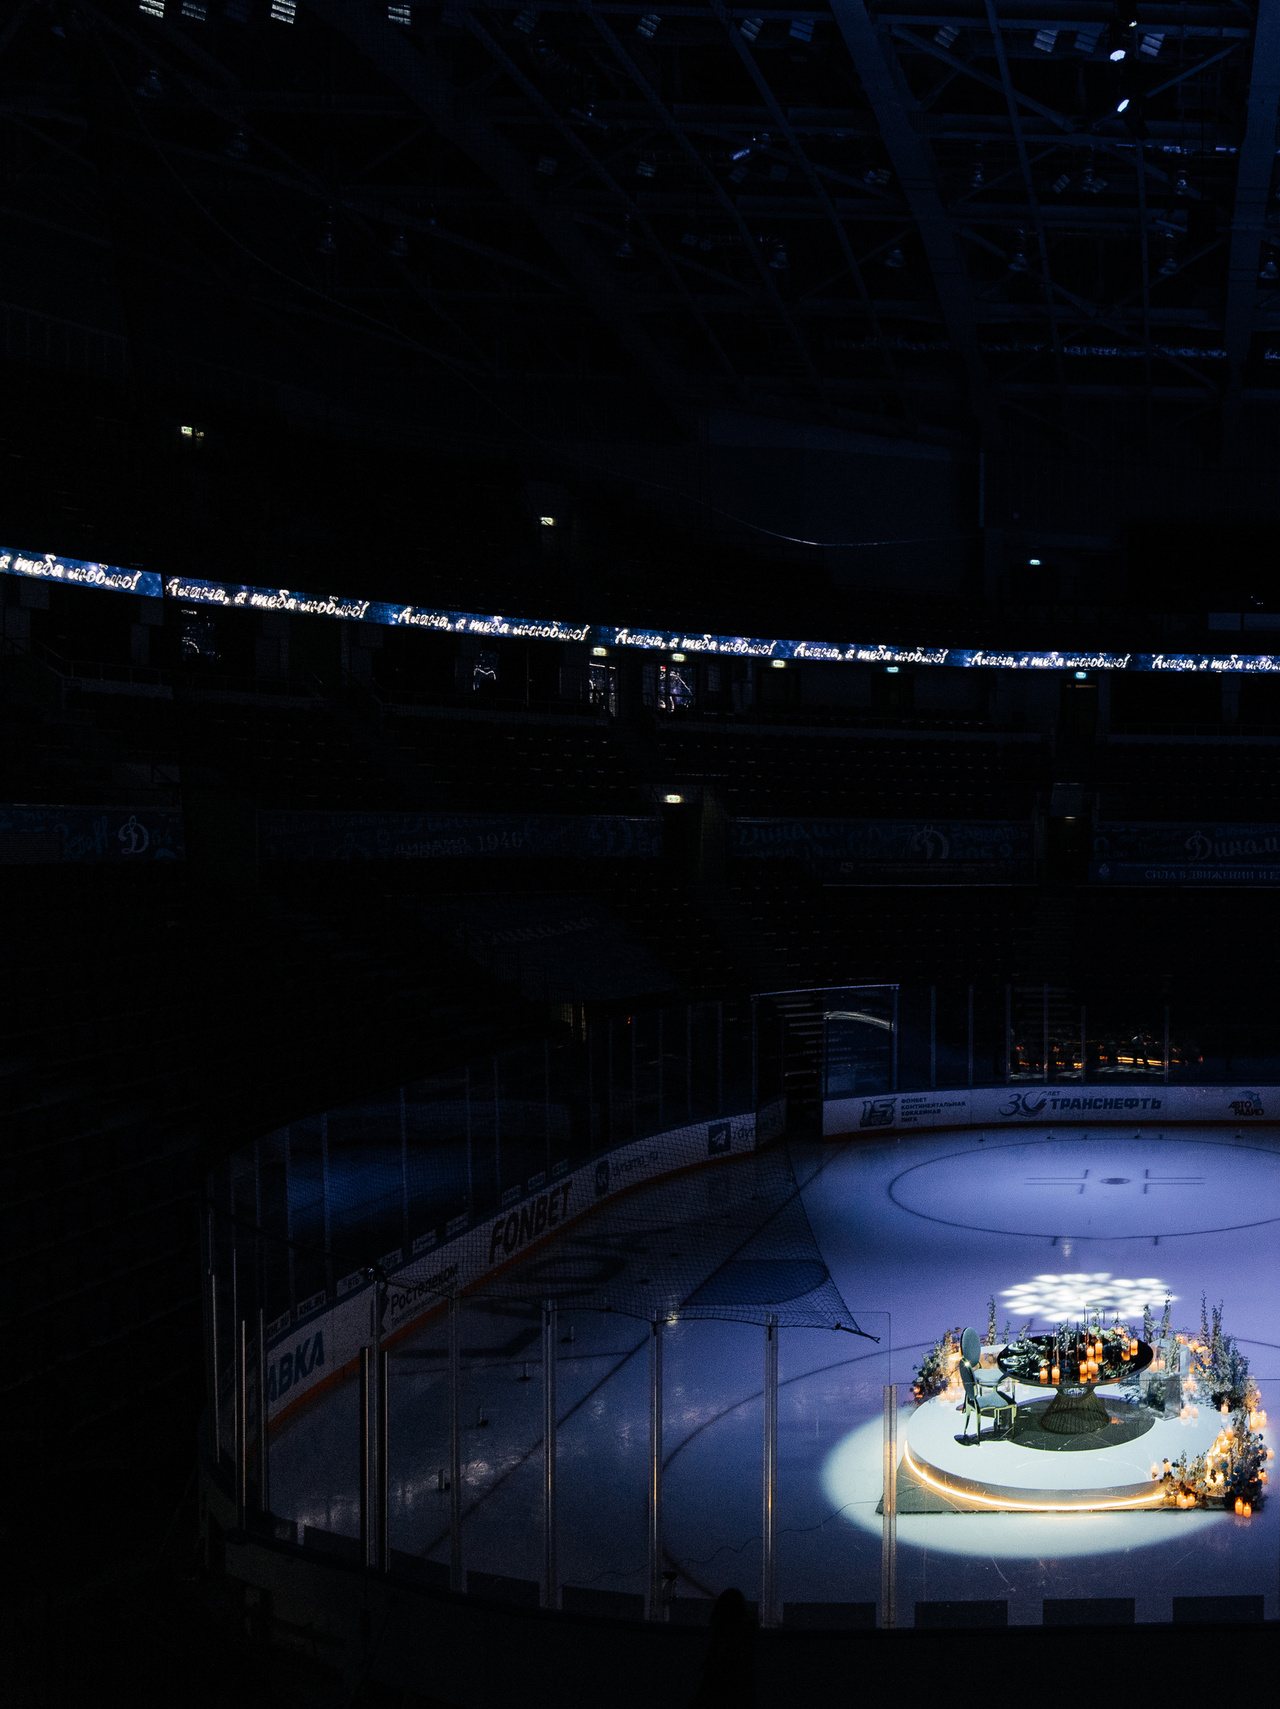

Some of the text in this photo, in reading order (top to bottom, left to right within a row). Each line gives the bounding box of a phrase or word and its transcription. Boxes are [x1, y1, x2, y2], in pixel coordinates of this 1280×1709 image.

[14, 554, 62, 577] тебя
[165, 578, 229, 604] Алана,
[251, 589, 296, 609] тебя
[398, 606, 452, 630] Алана,
[469, 615, 509, 634] тебя
[615, 628, 666, 649] Алана,
[682, 634, 716, 651] тебя
[794, 643, 842, 660] Алана,
[857, 645, 891, 660] тебя
[971, 651, 1017, 668] Алана,
[1031, 651, 1063, 667] тебя
[1152, 655, 1196, 670] Алана,
[1211, 655, 1243, 670] тебя
[1050, 1097, 1162, 1110] ТРАНСНЕФТЬ
[489, 1179, 574, 1265] FONBET
